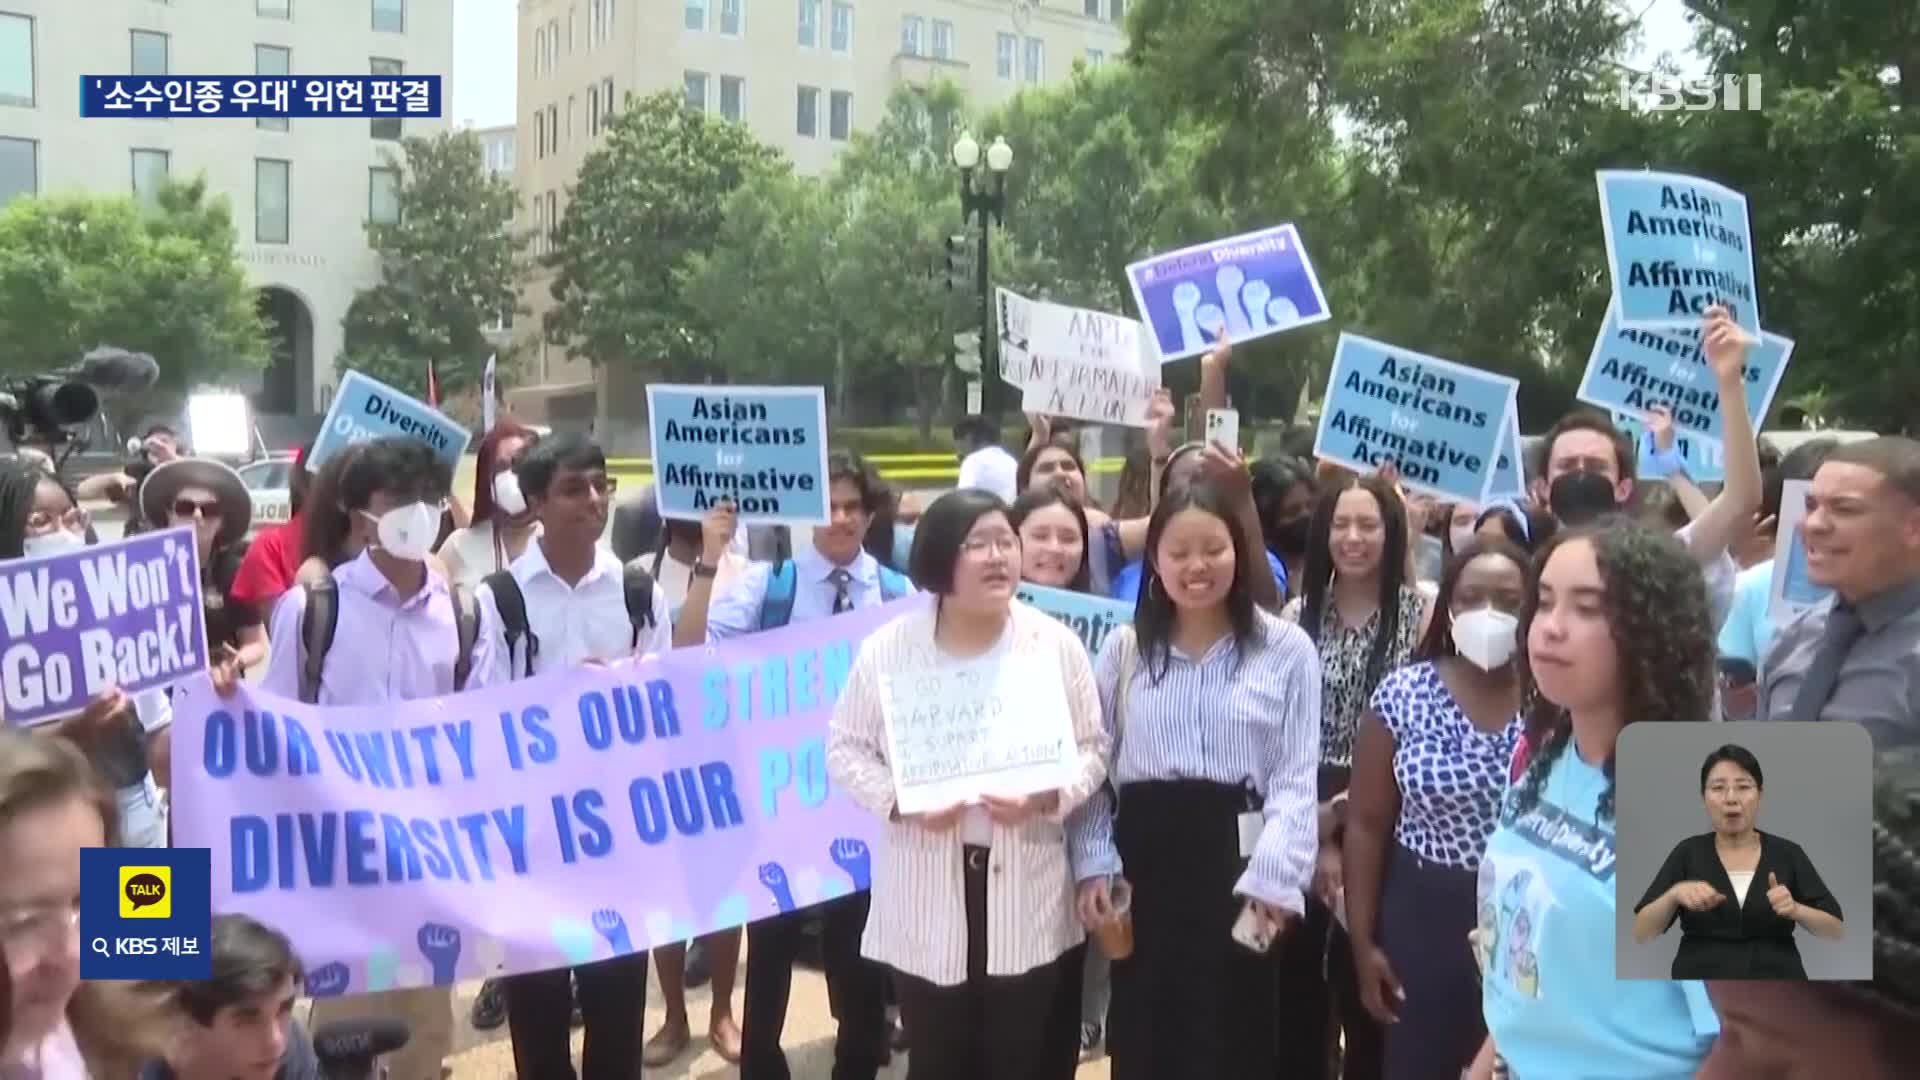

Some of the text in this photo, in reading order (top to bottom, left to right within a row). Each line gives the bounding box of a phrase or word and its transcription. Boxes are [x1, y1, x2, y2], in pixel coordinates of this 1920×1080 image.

[1660, 185, 1722, 217] Asian
[1627, 209, 1744, 252] Americans
[1628, 260, 1751, 302] Affirmative
[1379, 356, 1457, 396] Asian
[1618, 327, 1761, 384] Ameris
[693, 395, 767, 422] Asian
[1344, 369, 1488, 429] Americans
[1601, 357, 1721, 412] Affirmati
[365, 393, 449, 450] Diversity
[665, 418, 806, 446] Americans
[1331, 409, 1482, 473] Affirmative
[1390, 410, 1420, 432] for
[665, 462, 815, 492] Affirmative
[715, 448, 744, 467] for
[0, 537, 193, 640] We Won't
[2, 603, 196, 712] Go Back!
[203, 639, 851, 788] OUR UNITY IS OUR STREN
[229, 804, 528, 893] DIVERSITY
[551, 789, 613, 864] IS
[628, 760, 744, 845] OUR
